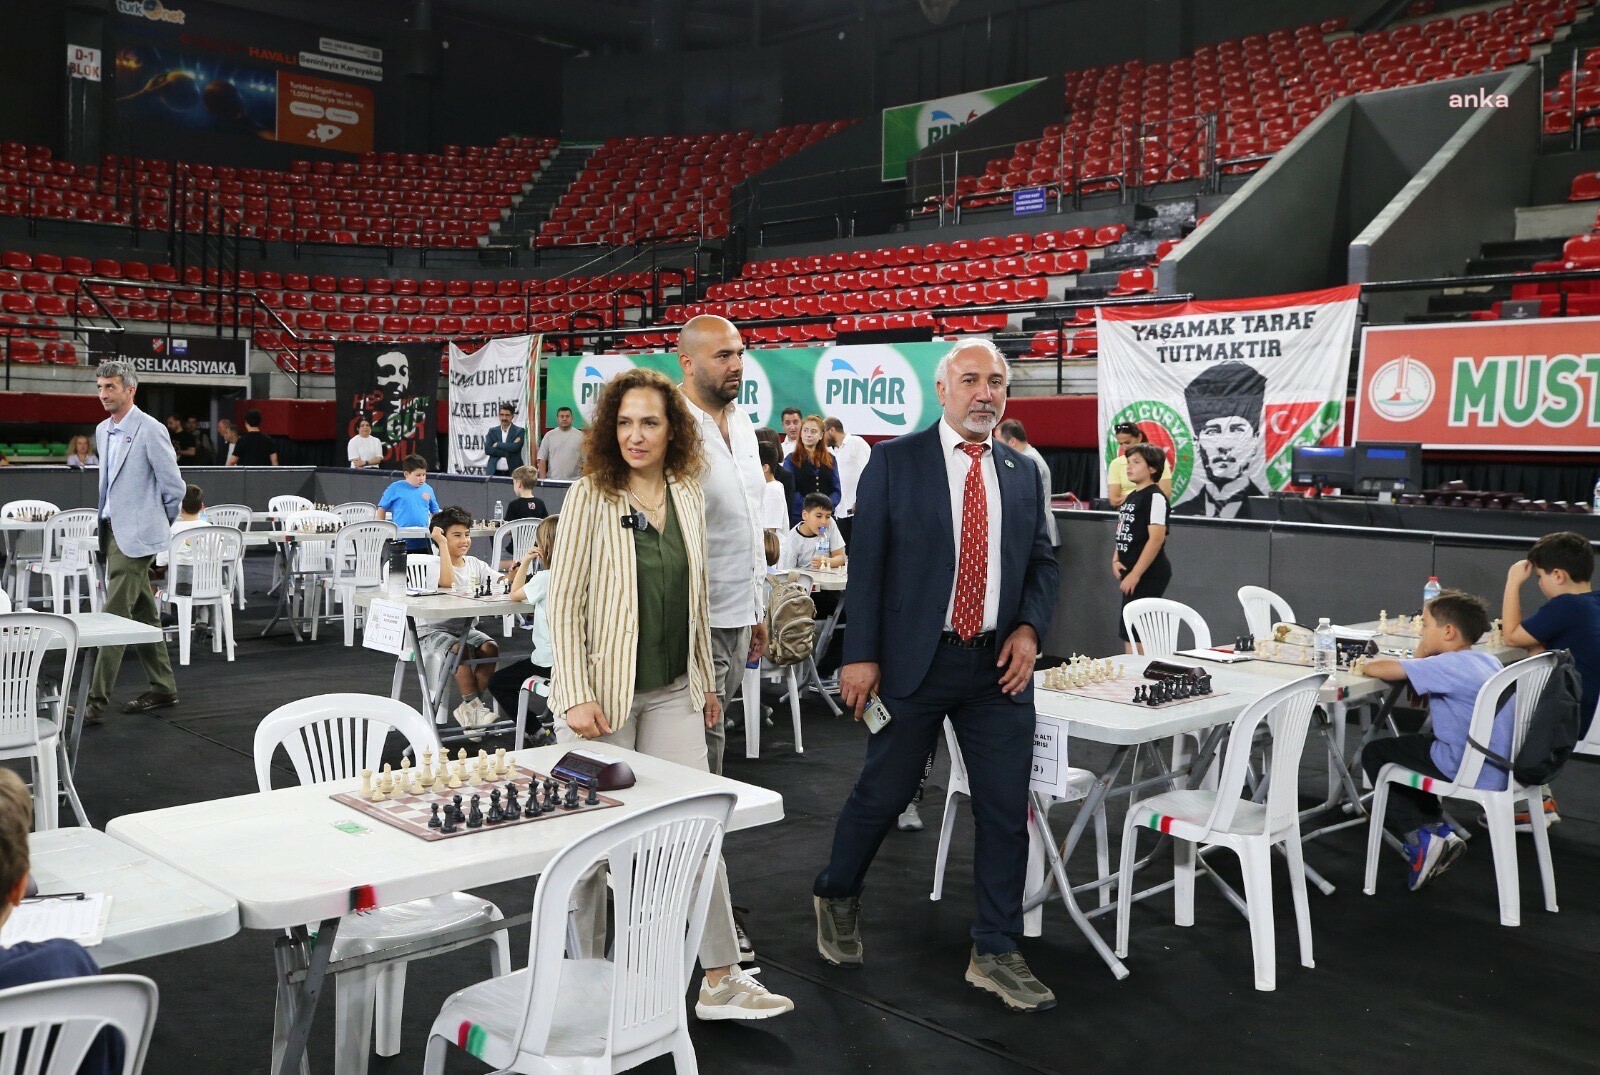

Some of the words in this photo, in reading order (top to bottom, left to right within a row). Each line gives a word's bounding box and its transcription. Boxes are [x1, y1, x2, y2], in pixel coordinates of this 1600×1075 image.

[75, 48, 94, 62] D-1
[69, 62, 100, 78] BLOK
[1131, 317, 1236, 344] YAŞAMAK
[1241, 310, 1316, 334] TARAF
[1156, 339, 1282, 363] TUTMAKTIR
[99, 354, 237, 374] ÜKSELKARŞIYAKA
[825, 378, 906, 405] PINAR
[1138, 404, 1188, 449] CURVA
[1040, 733, 1052, 741] ALTI
